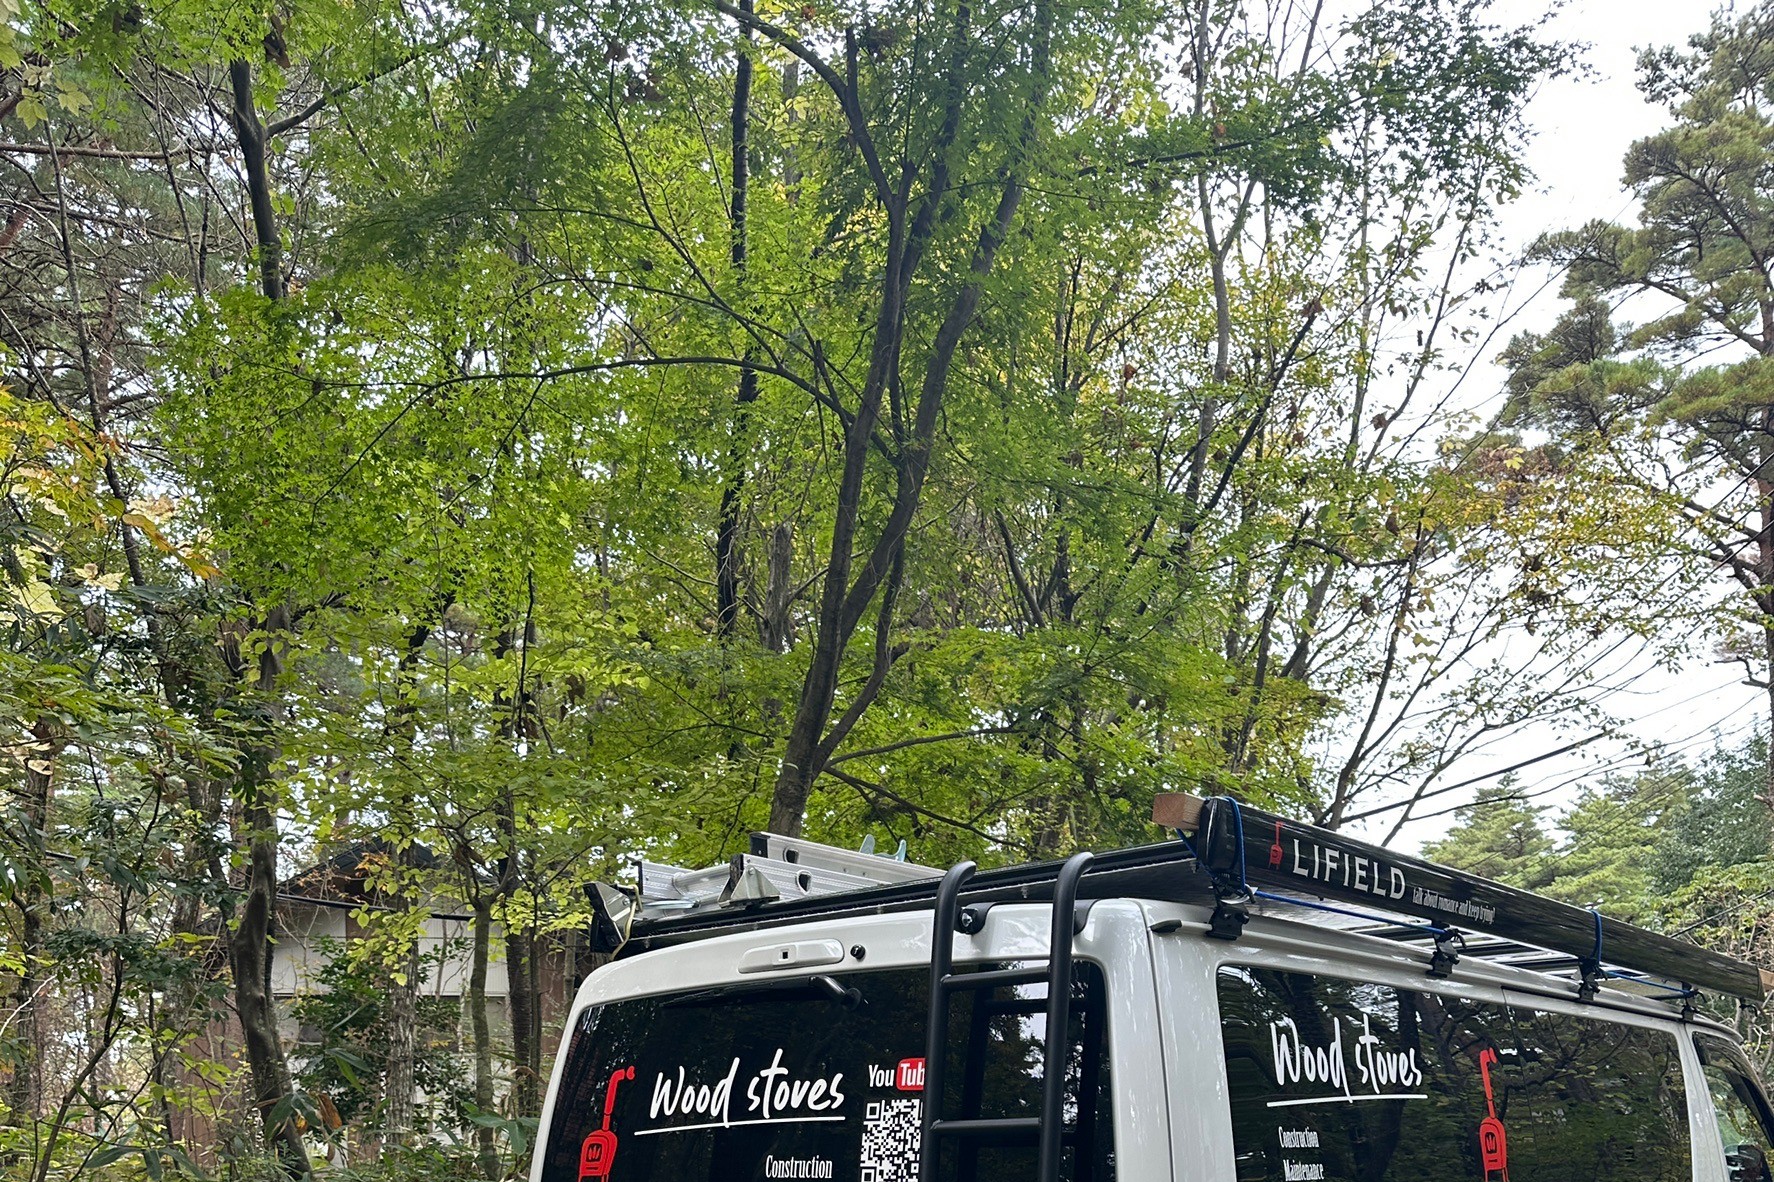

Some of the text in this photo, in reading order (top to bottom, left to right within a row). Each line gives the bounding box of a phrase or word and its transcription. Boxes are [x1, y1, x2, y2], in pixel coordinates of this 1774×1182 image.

[1293, 839, 1406, 900] LIFIELD
[1271, 1013, 1423, 1103] Wood stoves
[649, 1048, 845, 1128] Wood stoves
[1278, 1126, 1320, 1148] Construction
[765, 1154, 833, 1180] Construction
[1283, 1159, 1325, 1181] Maintenance
